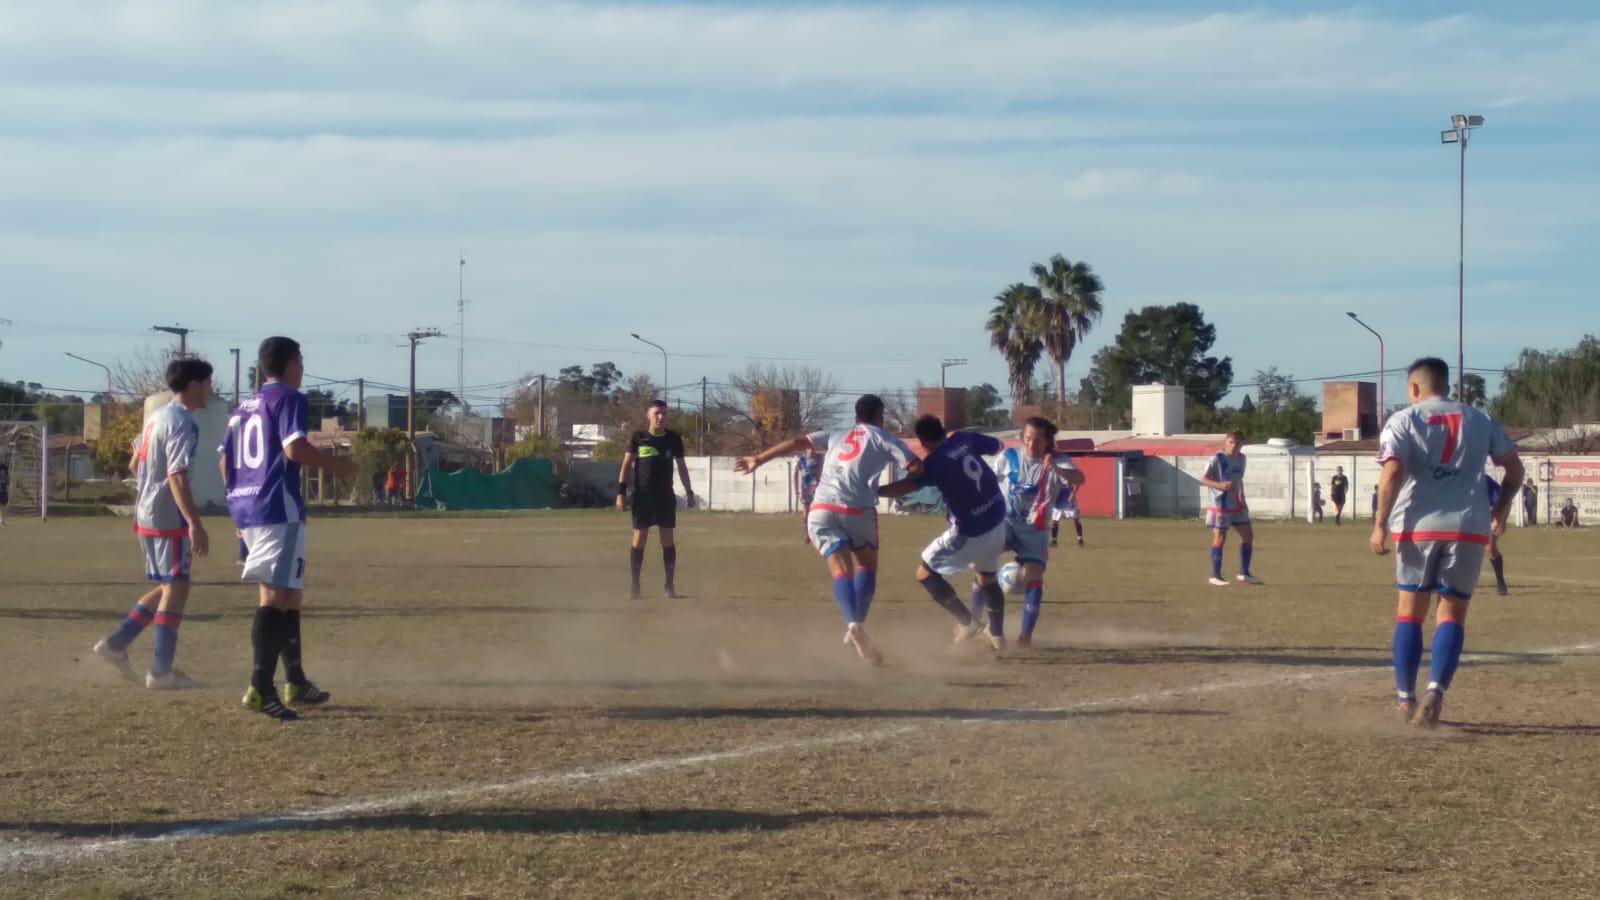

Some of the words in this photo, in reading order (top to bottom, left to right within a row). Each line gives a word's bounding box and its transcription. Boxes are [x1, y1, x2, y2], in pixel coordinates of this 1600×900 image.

[228, 414, 265, 469] 10
[837, 430, 866, 461] 5
[1427, 414, 1463, 465] 7
[963, 454, 983, 491] 9
